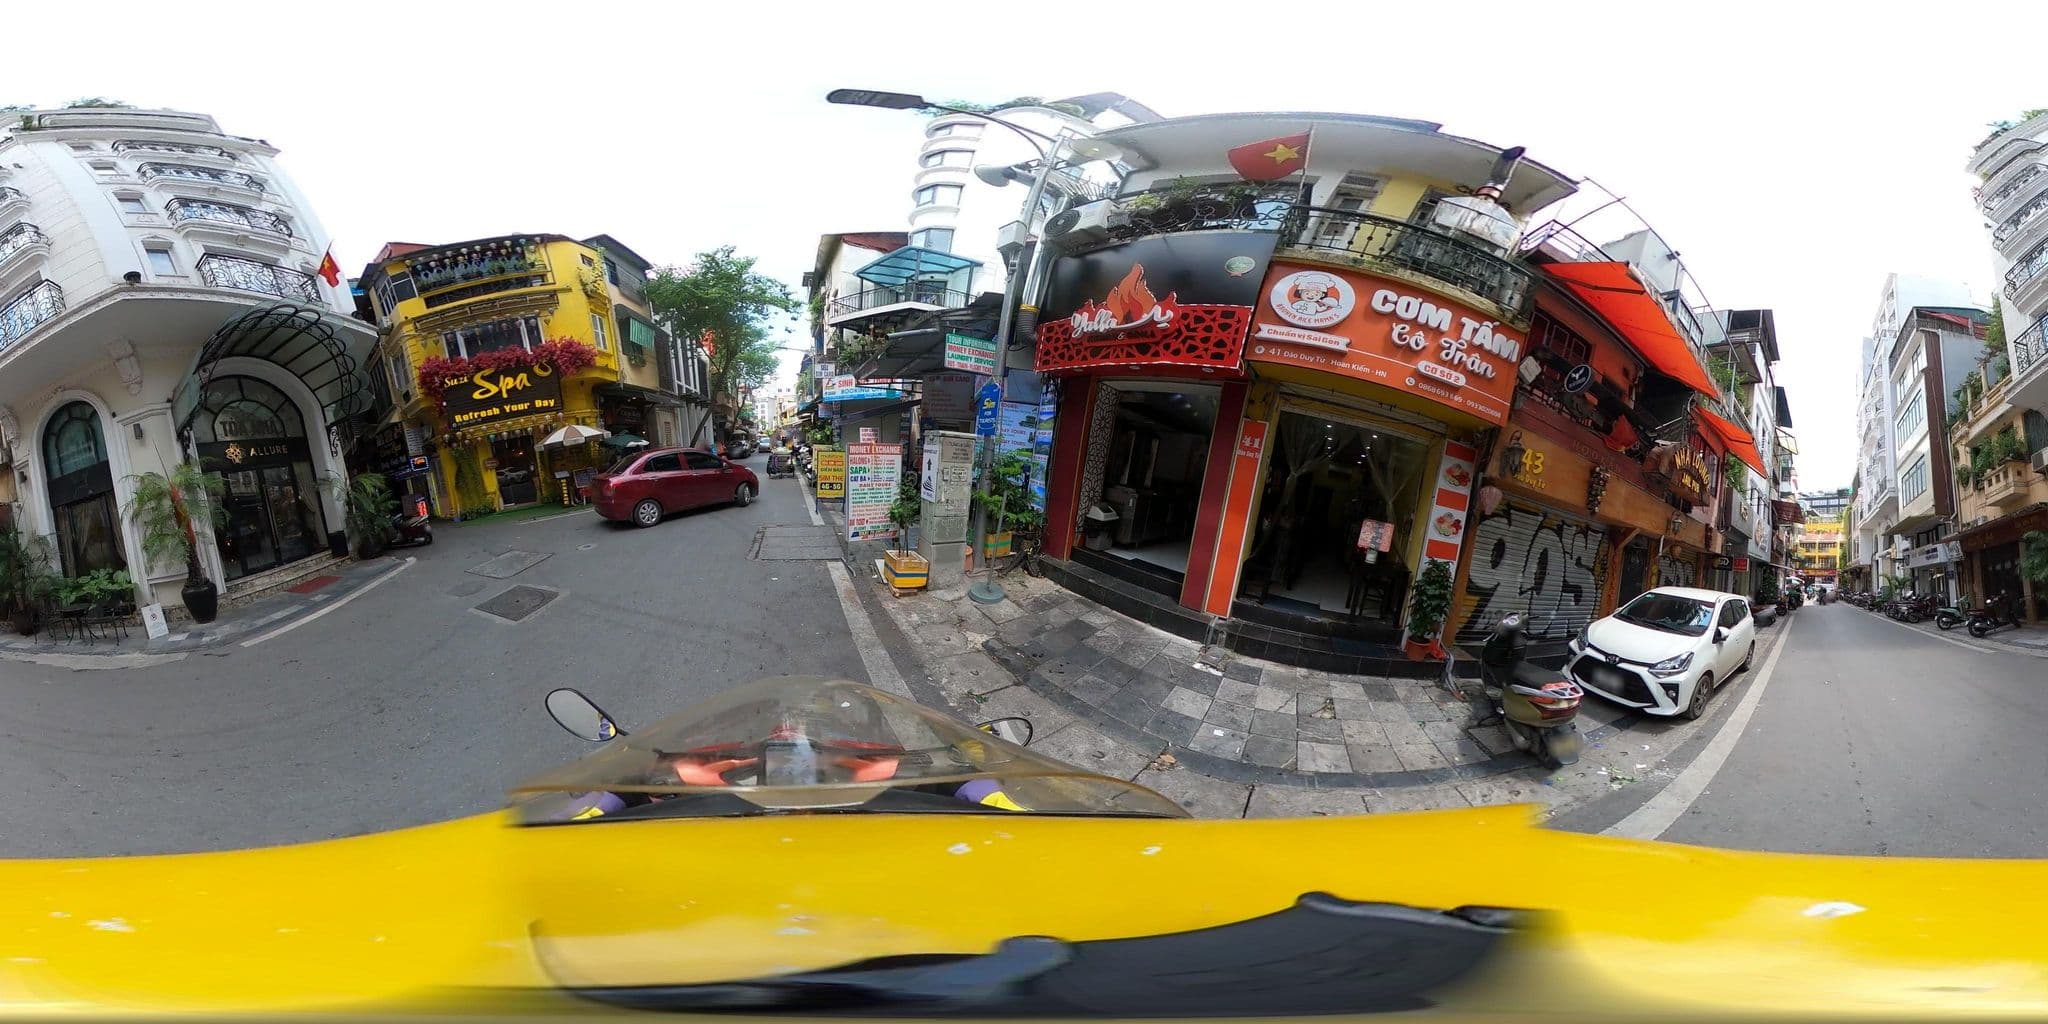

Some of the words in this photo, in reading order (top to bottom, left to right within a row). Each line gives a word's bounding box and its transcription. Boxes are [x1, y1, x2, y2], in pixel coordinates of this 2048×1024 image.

[1371, 289, 1452, 332] CƠM
[1460, 316, 1519, 362] TẤM
[948, 335, 962, 345] TOUR
[948, 344, 967, 353] MONEY
[1392, 322, 1428, 350] Cô
[1440, 338, 1496, 379] Trân
[948, 352, 973, 362] LAUNDRY
[1269, 348, 1281, 356] 41
[1300, 353, 1315, 363] Duy
[1375, 369, 1387, 378] HN
[472, 368, 532, 399] Spa
[838, 378, 853, 388] SINH
[1453, 375, 1461, 383] 2
[454, 407, 500, 423] Refresh
[503, 402, 531, 413] Your
[534, 398, 555, 408] Day
[1242, 435, 1260, 448] 41
[250, 445, 288, 457] ALLURE
[849, 445, 871, 454] MONEY
[872, 445, 901, 454] EXCHANGE
[849, 456, 868, 465] HALONG
[1522, 448, 1545, 475] 43
[850, 466, 867, 475] SAPA
